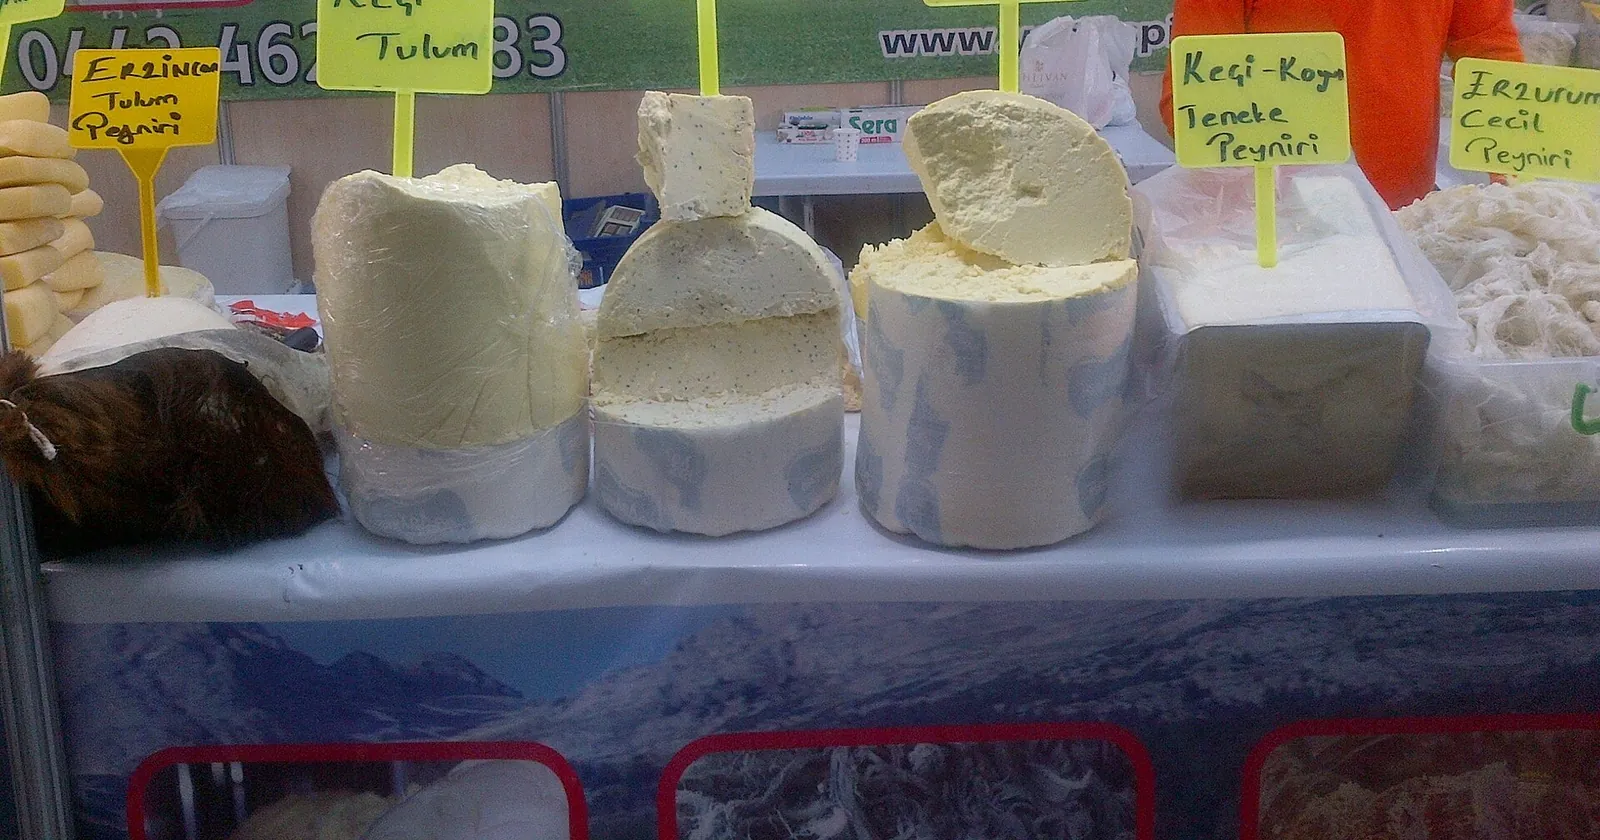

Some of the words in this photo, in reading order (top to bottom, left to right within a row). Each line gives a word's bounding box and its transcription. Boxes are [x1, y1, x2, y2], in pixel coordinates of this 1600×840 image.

[355, 33, 479, 61] Tulum
[92, 91, 179, 111] Tulum
[72, 111, 182, 145] Peyniri
[848, 115, 898, 135] Sera
[1178, 102, 1289, 129] Teneke
[1460, 109, 1545, 133] Cecil
[1205, 132, 1319, 163] Peyniri
[1464, 136, 1573, 172] Peyniri
